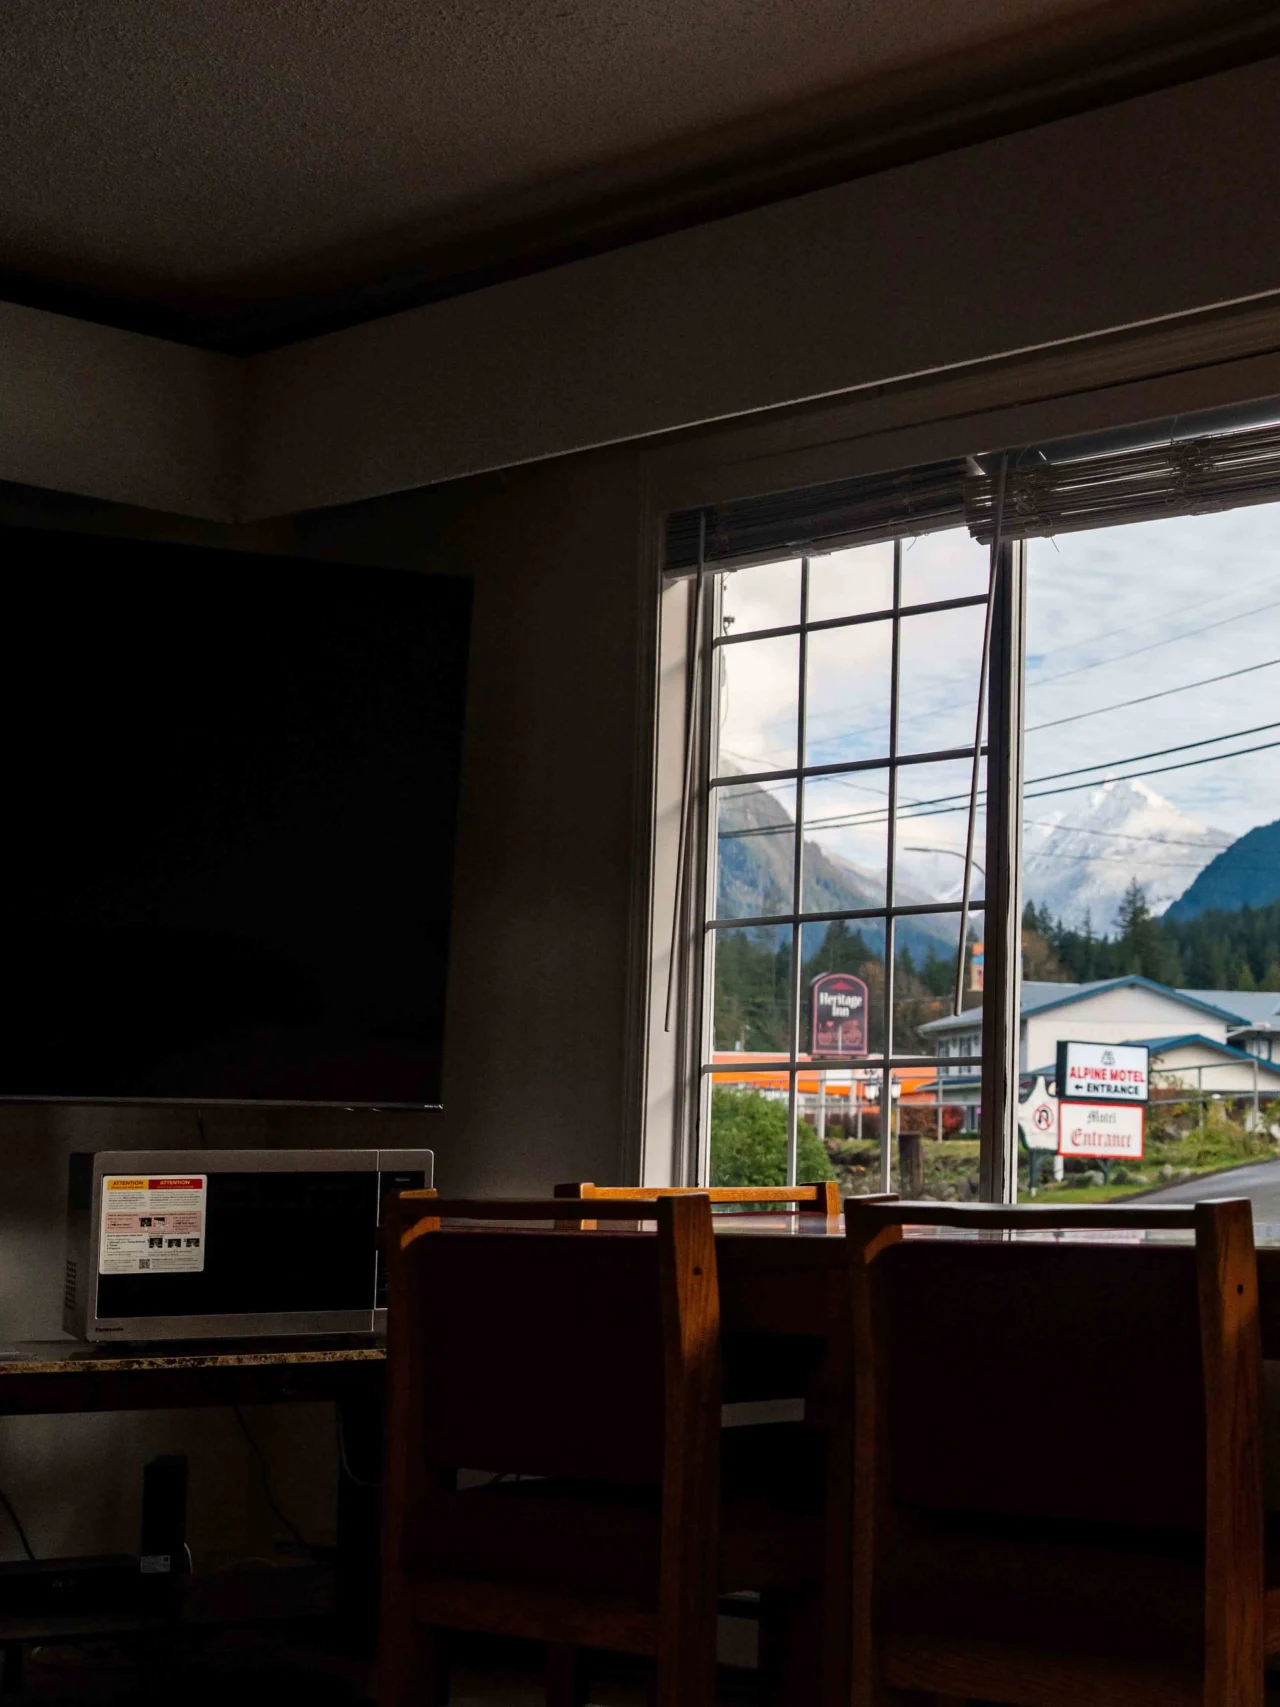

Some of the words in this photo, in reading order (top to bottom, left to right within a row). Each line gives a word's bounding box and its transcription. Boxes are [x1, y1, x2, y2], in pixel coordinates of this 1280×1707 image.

[819, 992, 863, 1009] Heritage
[832, 1004, 850, 1017] Inn
[1069, 1066, 1107, 1080] ALPINE
[1110, 1069, 1145, 1083] MOTEL
[1086, 1083, 1140, 1095] ENTRANCE
[1071, 1128, 1131, 1148] Entrance
